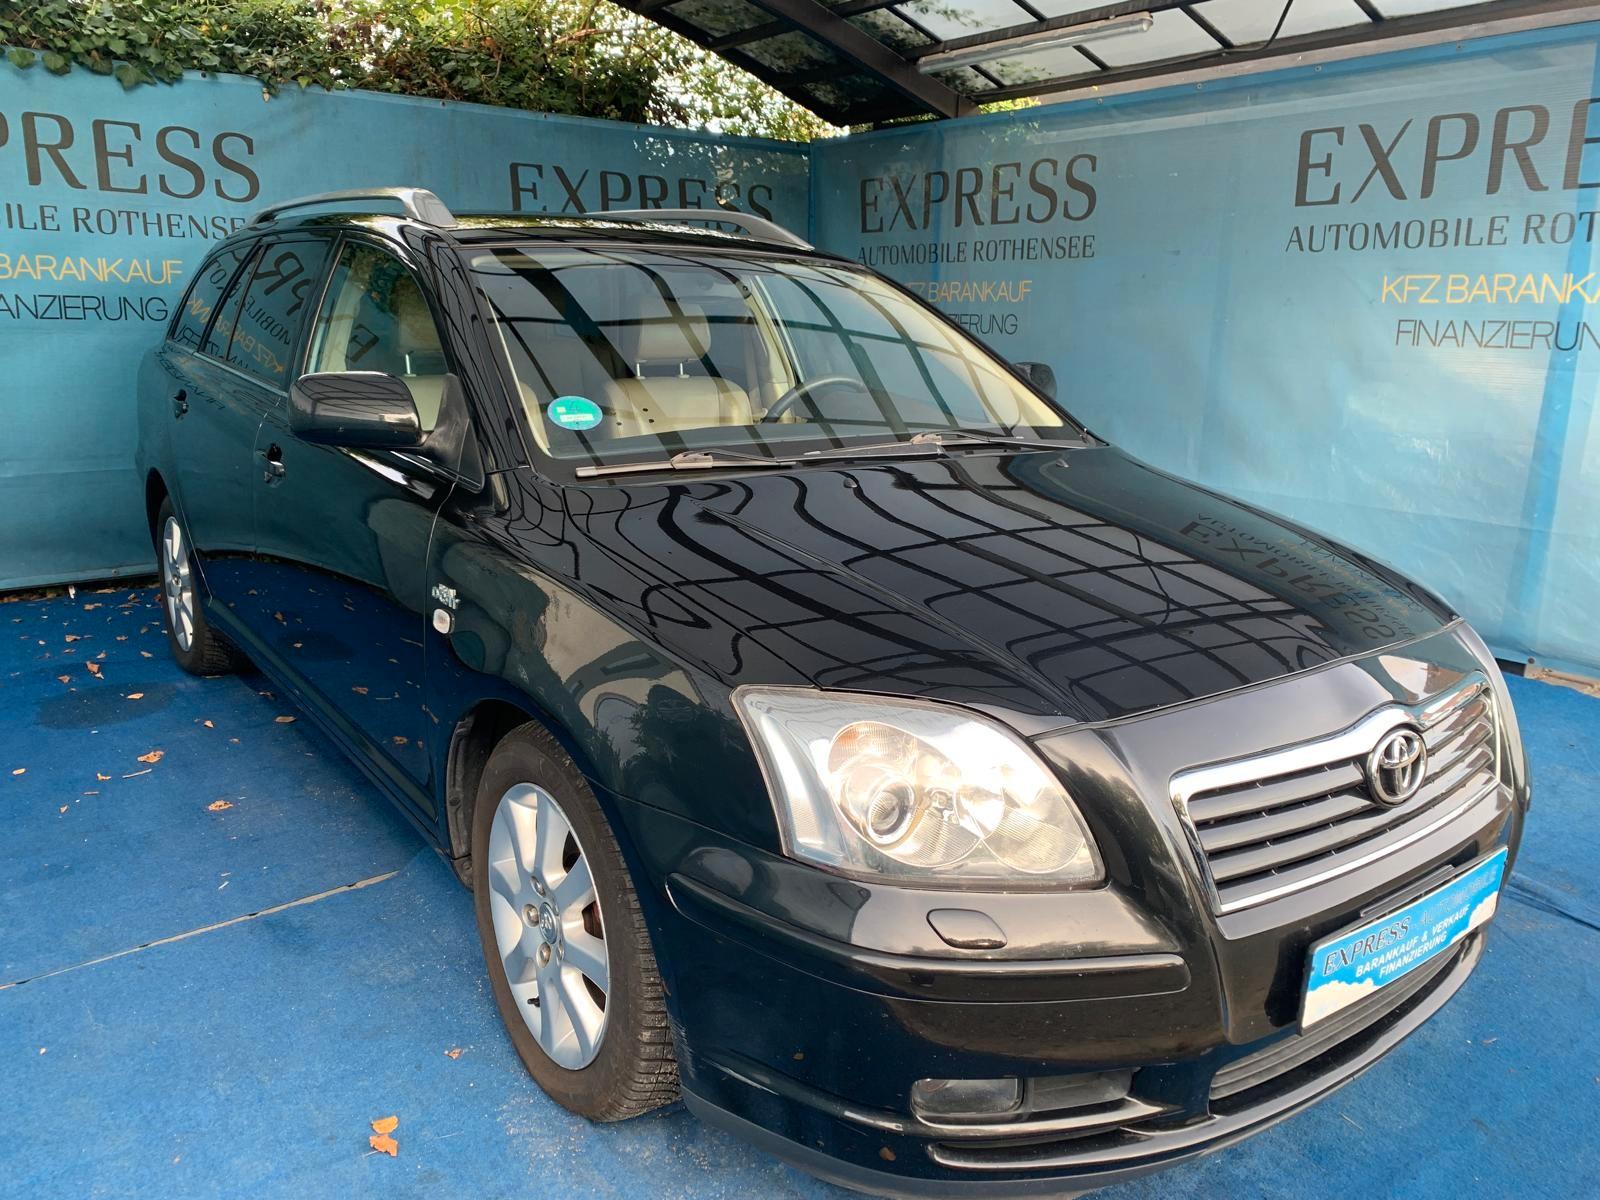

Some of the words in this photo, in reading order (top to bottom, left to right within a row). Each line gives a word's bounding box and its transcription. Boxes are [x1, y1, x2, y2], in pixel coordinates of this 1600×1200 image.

[859, 153, 1098, 233] EXPRESS
[857, 241, 967, 266] AUTOMOBILE
[973, 235, 1096, 262] ROTHENSEE
[1285, 215, 1510, 253] AUTOMOBILE
[928, 280, 1033, 303] BARANKAUF
[1381, 274, 1441, 304] KFZ
[1323, 916, 1411, 976] EXPRESS
[1355, 936, 1419, 978] BARANKAUF
[1420, 931, 1428, 943] &
[1431, 904, 1470, 935] VERKAUF
[1379, 931, 1448, 979] FINANZIERUNG
